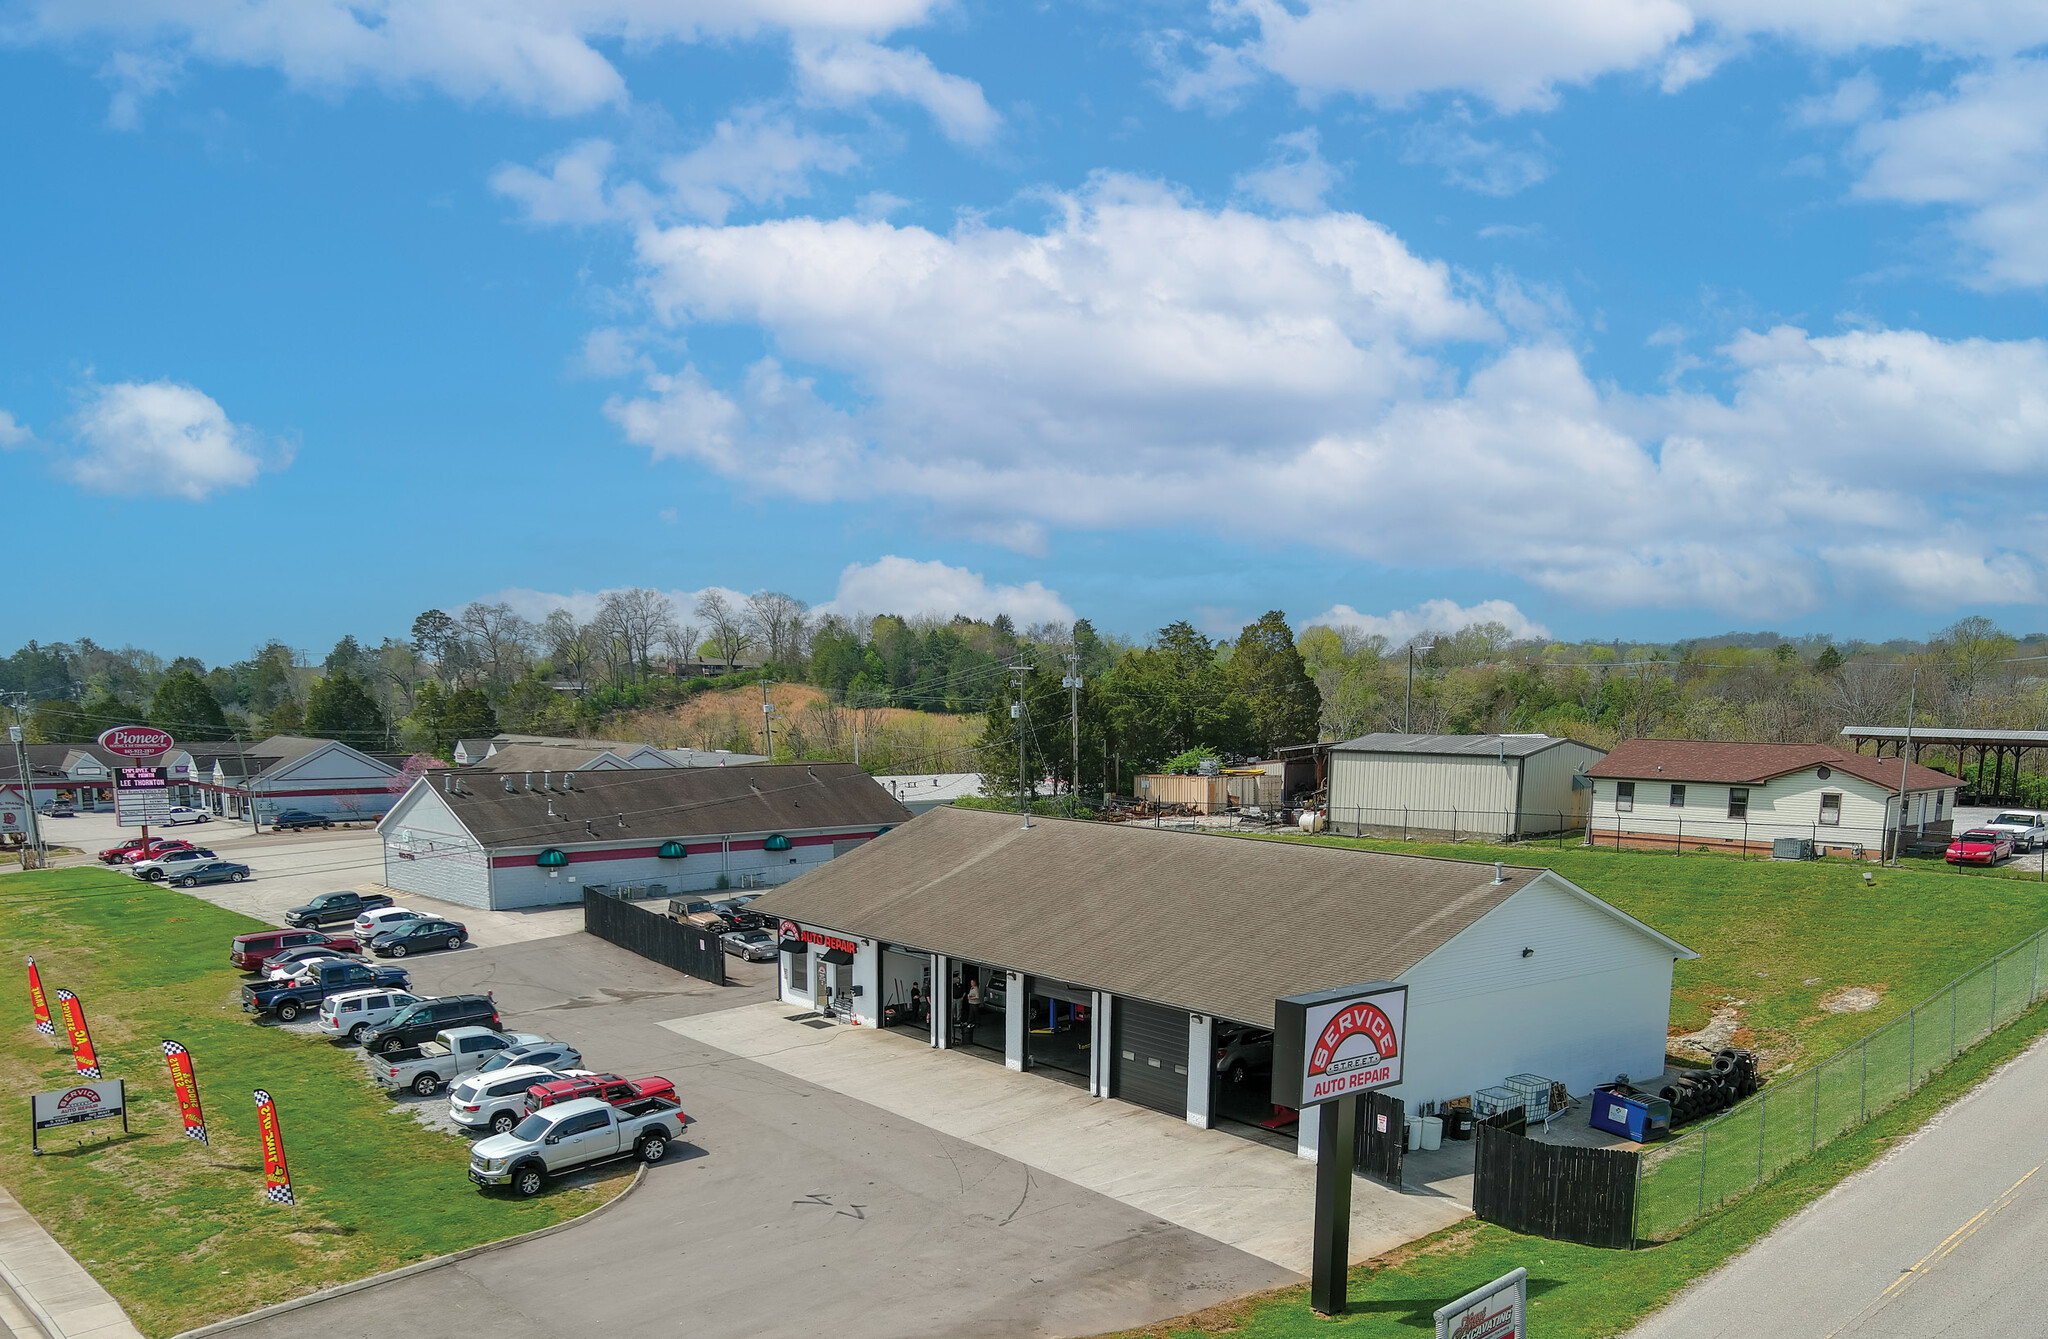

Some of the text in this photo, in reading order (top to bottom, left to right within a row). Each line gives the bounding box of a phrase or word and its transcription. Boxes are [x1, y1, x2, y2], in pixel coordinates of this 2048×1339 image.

[114, 731, 167, 744] Pioneer
[779, 921, 800, 941] SERVICE
[801, 930, 857, 954] AUTO REPAIR
[1314, 1009, 1394, 1069] SERVICE
[1333, 1056, 1374, 1072] STREET
[1313, 1066, 1390, 1098] AUTO REPAIR
[59, 1089, 99, 1107] SERVICE
